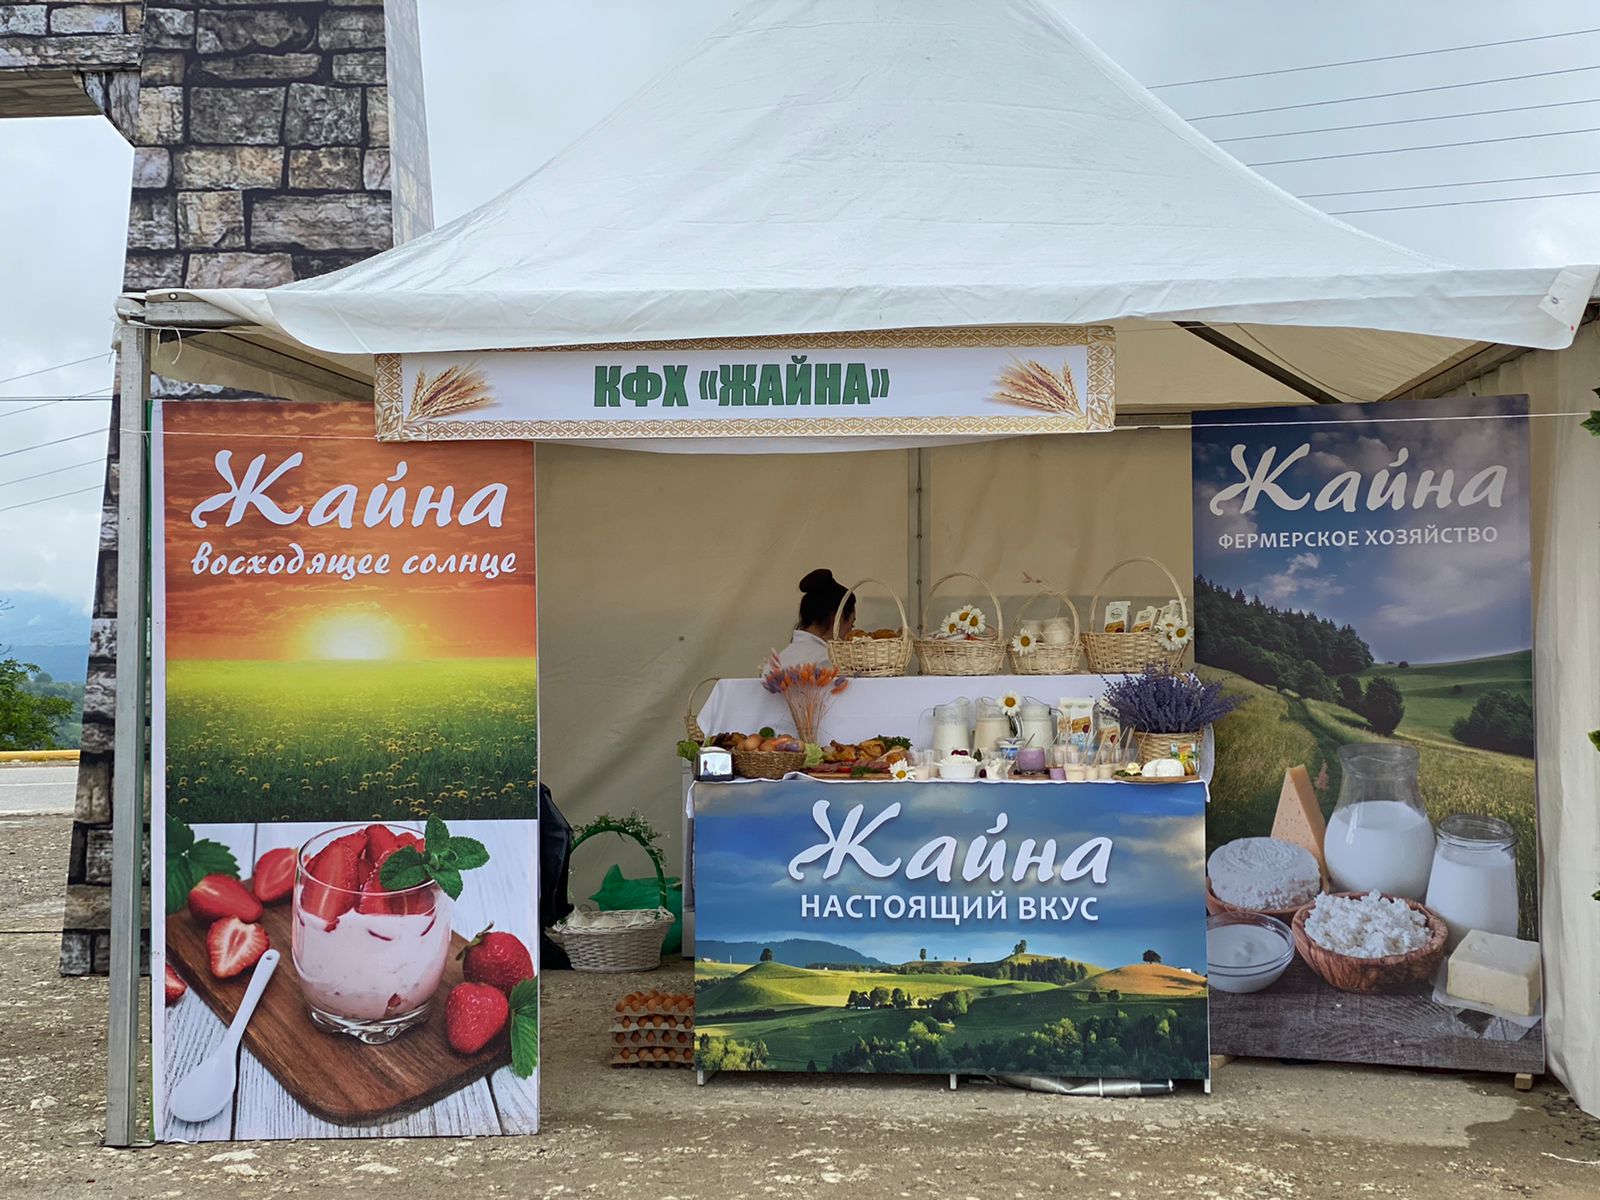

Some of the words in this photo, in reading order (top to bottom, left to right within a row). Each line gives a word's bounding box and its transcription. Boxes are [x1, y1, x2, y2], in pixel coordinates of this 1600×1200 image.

[594, 365, 689, 407] КФХ
[699, 355, 890, 407] «ЖАЙНА»
[190, 449, 508, 529] Жайна
[1209, 442, 1508, 516] Жайна
[190, 541, 391, 580] восходящее
[401, 552, 517, 579] солнце
[1218, 530, 1359, 549] ФЕРМЕРСКОЕ
[1365, 525, 1498, 546] ХОЗЯЙСТВО
[788, 799, 1113, 884] Жайна
[801, 890, 1007, 925] НАСТОЯЩИЙ
[1018, 896, 1099, 921] ВКУС
